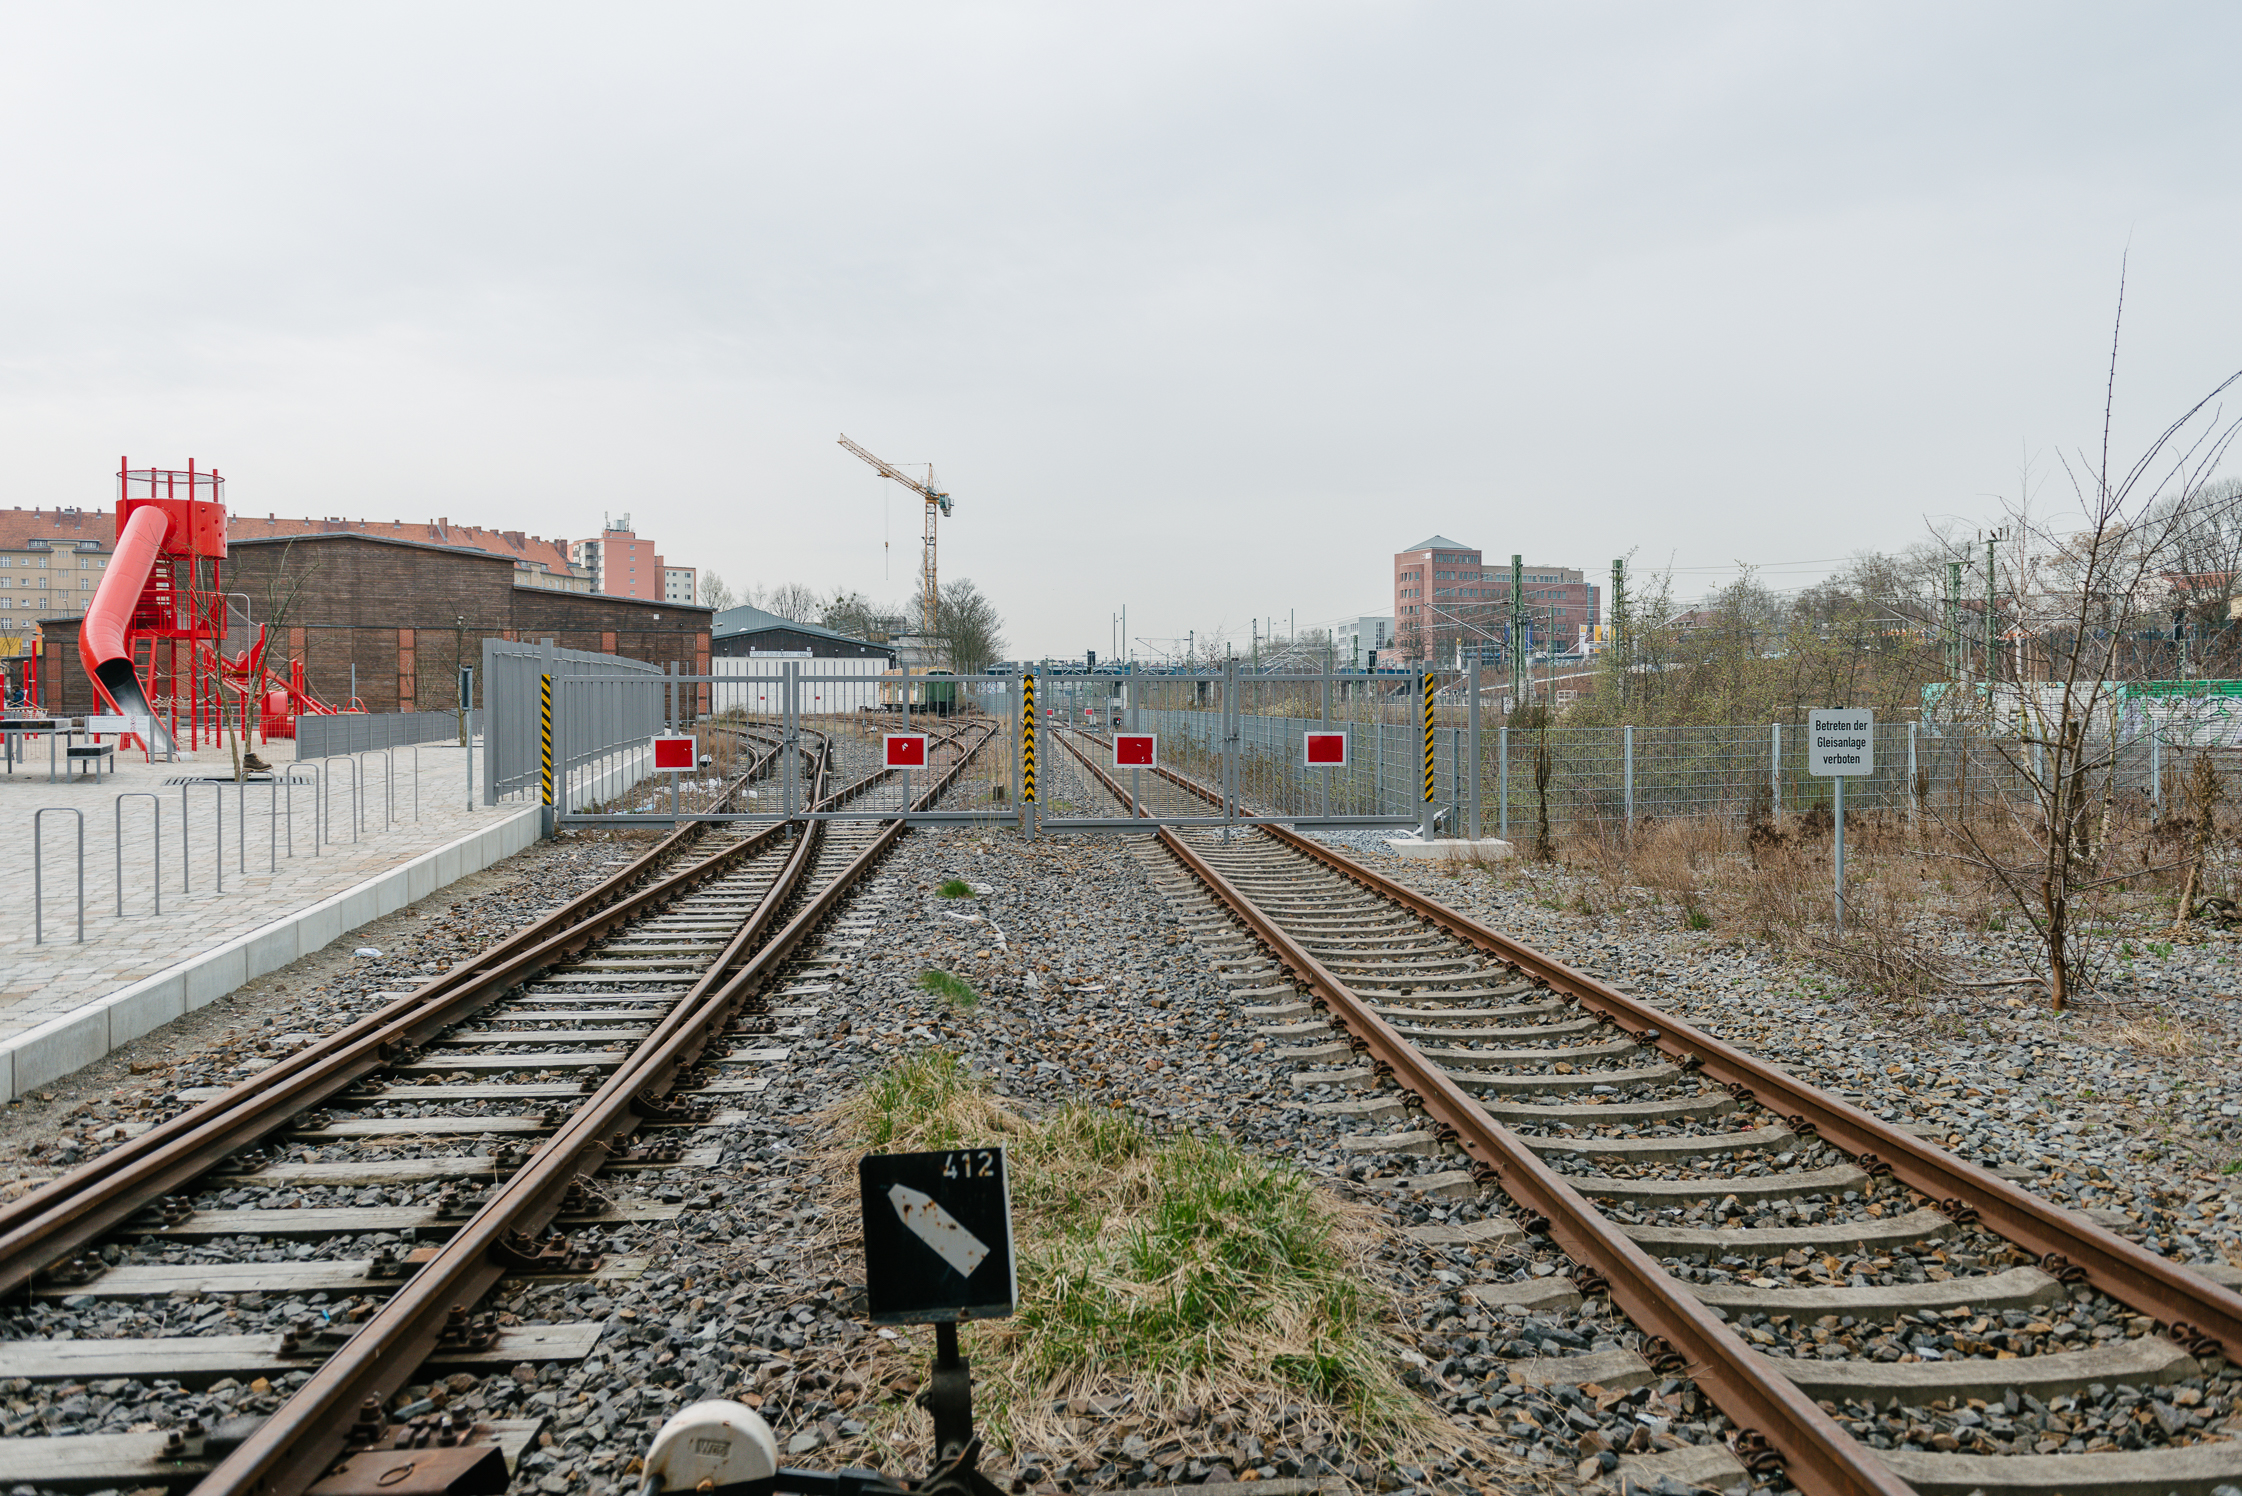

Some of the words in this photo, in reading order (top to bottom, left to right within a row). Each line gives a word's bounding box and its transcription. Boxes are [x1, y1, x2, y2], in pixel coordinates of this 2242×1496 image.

[1815, 720, 1851, 731] Betreten
[1853, 720, 1868, 731] der
[1817, 736, 1866, 750] Gleisanlage
[1823, 753, 1860, 764] verboten
[943, 1151, 994, 1179] 412
